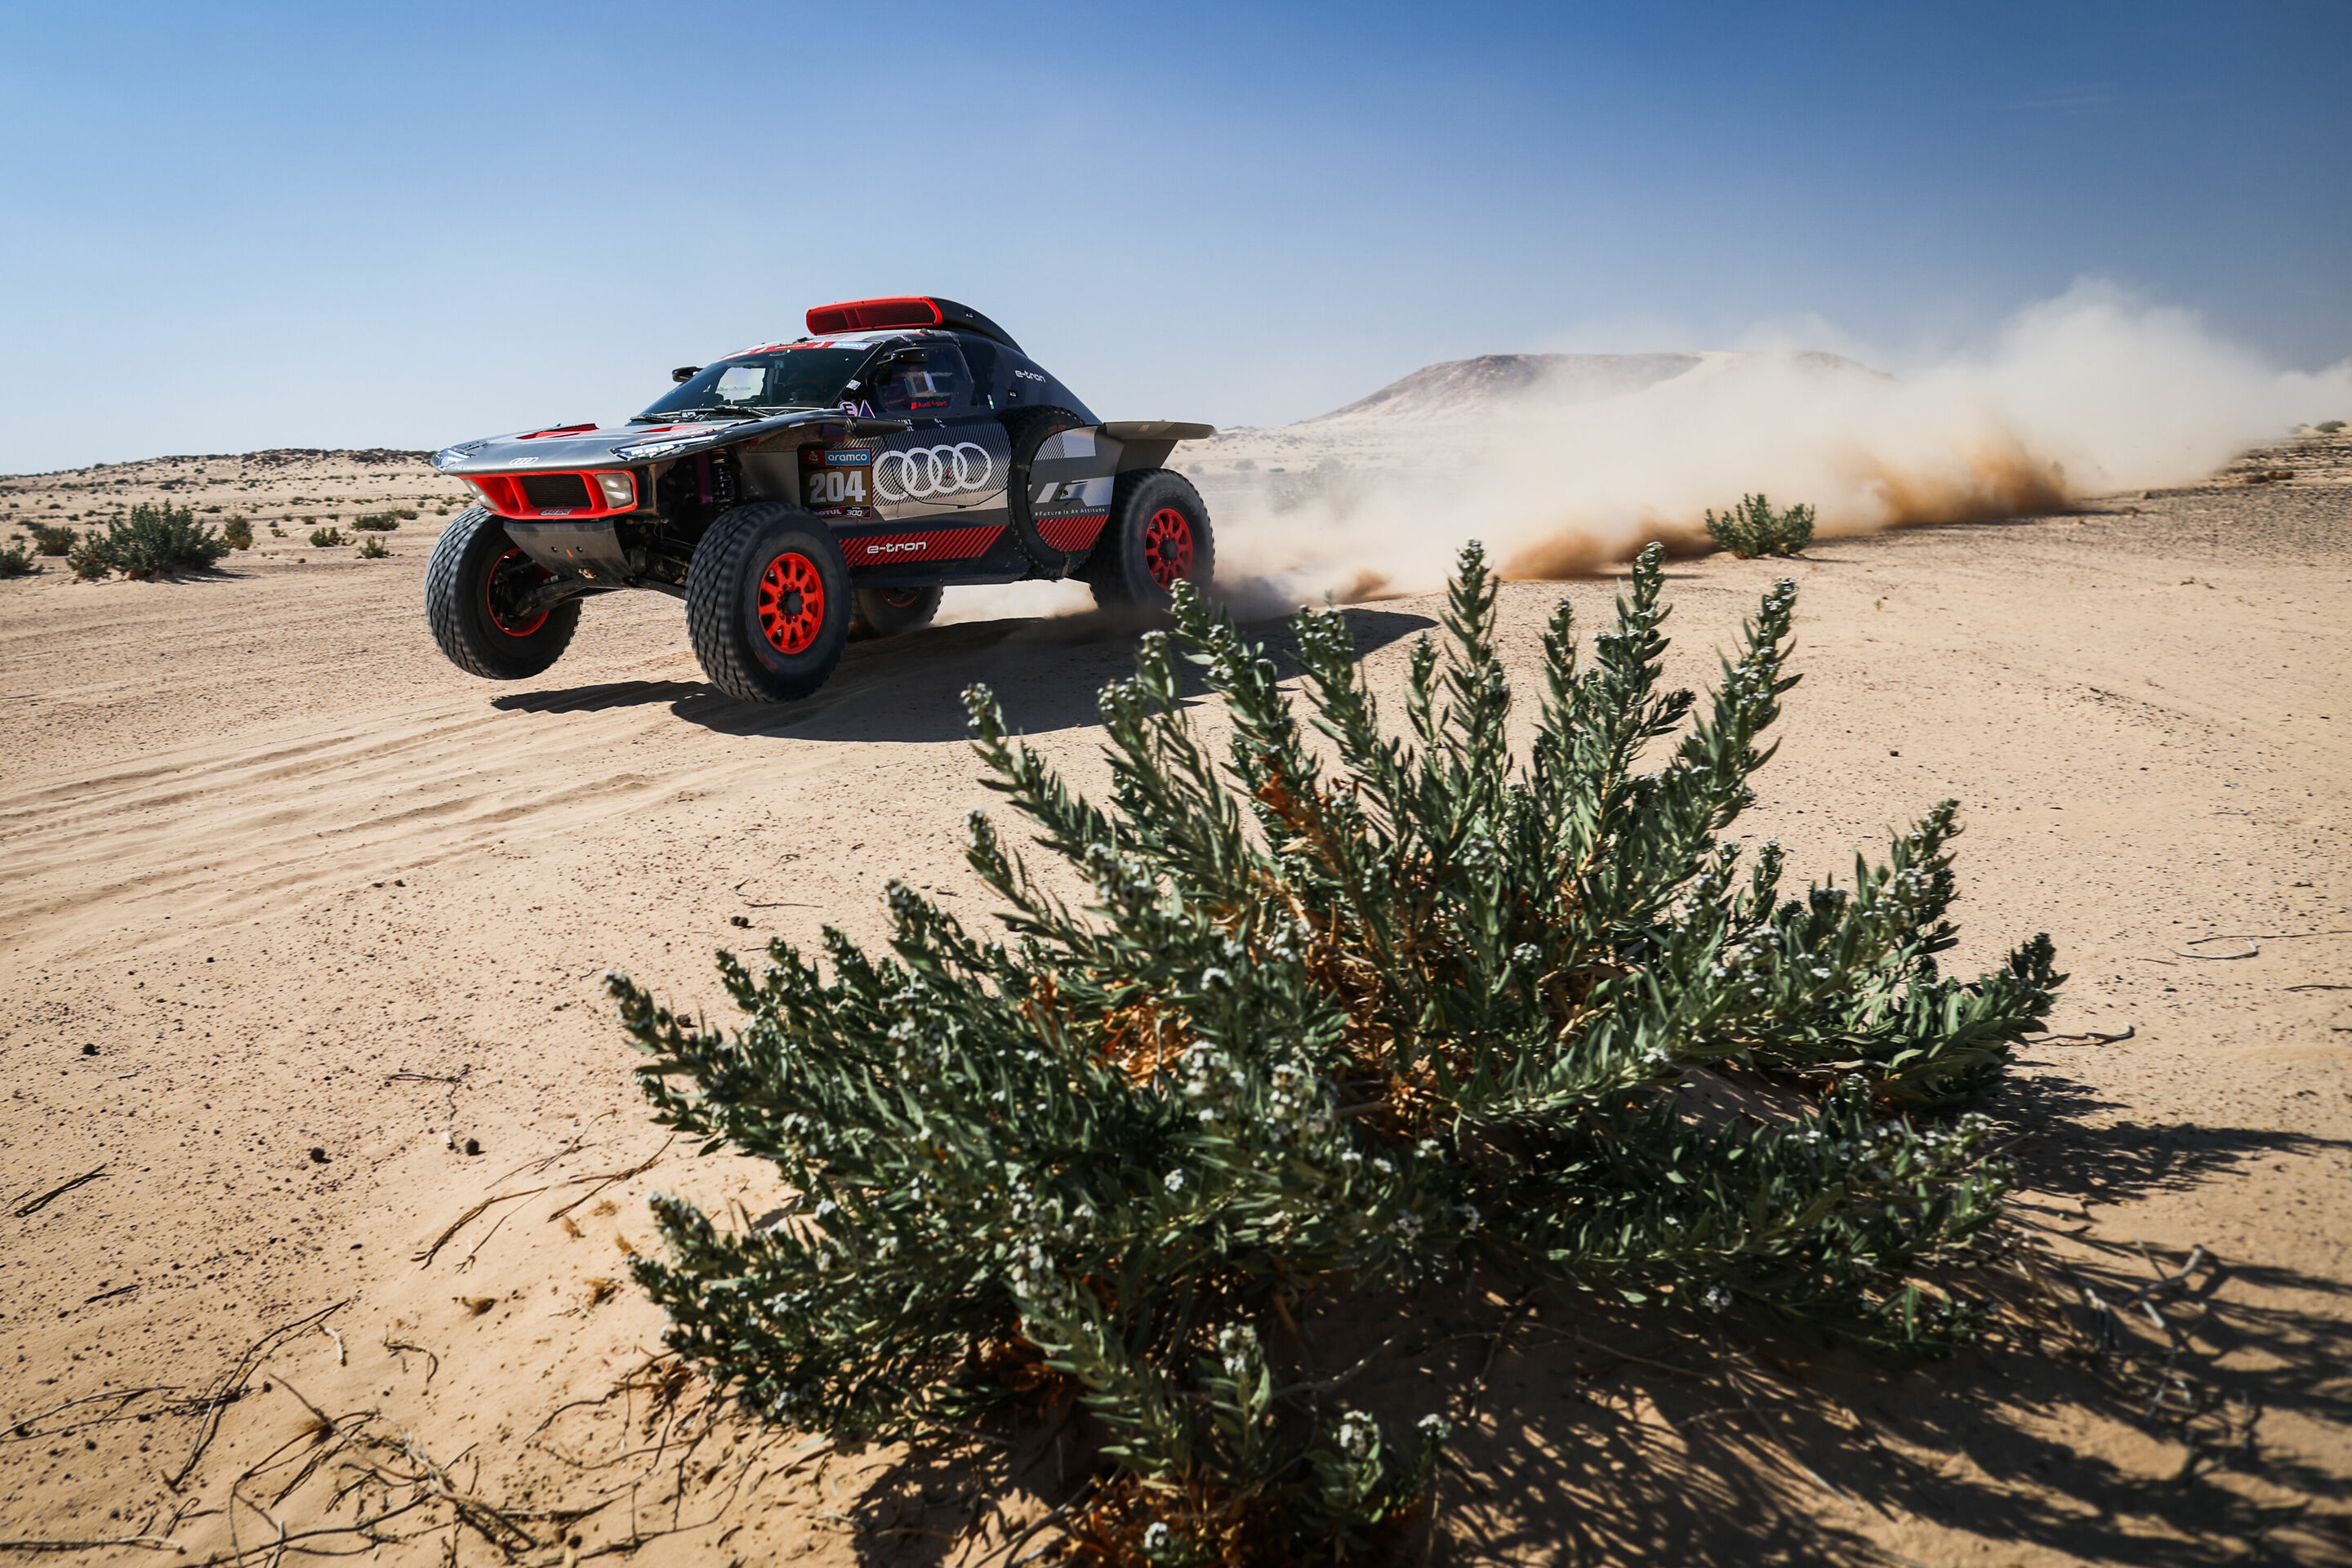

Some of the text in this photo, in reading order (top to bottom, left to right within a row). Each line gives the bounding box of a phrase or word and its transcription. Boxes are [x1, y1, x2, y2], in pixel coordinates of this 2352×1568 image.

[1015, 370, 1046, 383] e-tron
[828, 453, 867, 461] aramco
[809, 470, 866, 503] 204
[866, 541, 927, 554] e-tron
